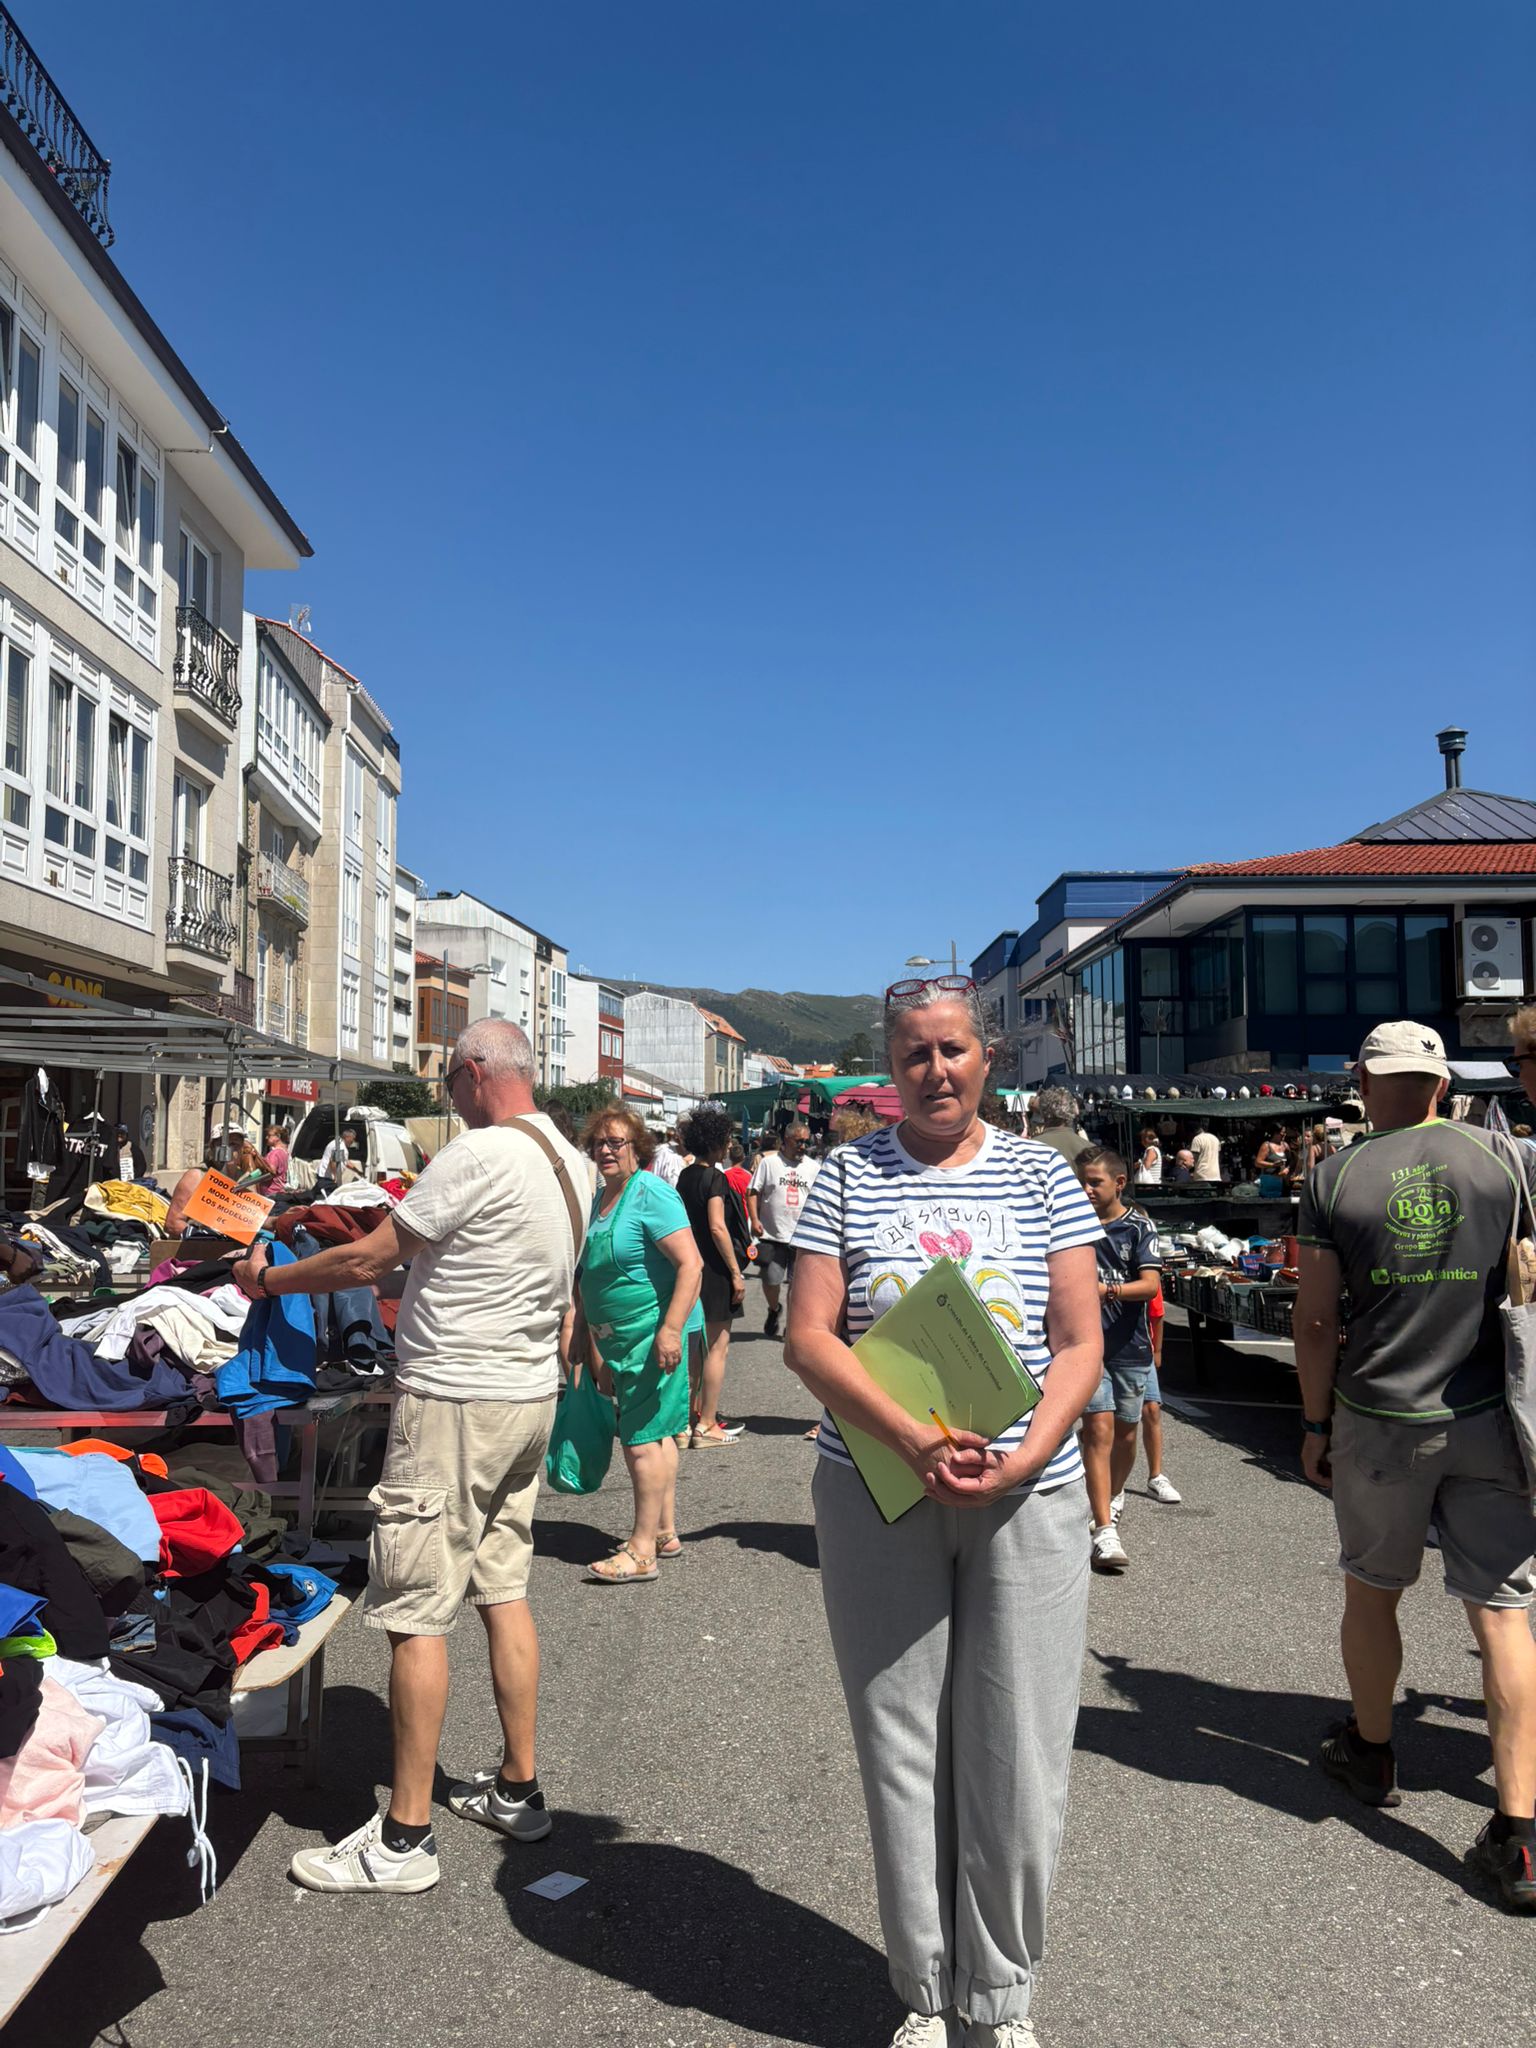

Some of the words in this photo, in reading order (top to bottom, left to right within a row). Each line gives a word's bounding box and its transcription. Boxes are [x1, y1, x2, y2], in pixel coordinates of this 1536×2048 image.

[1391, 1167, 1410, 1182] 131
[208, 1187, 230, 1203] MODA
[232, 1200, 257, 1216] TODOS
[209, 1174, 229, 1190] TODO
[230, 1186, 262, 1208] CALIDAD
[201, 1195, 216, 1208] LOS
[217, 1204, 254, 1225] MODELOS
